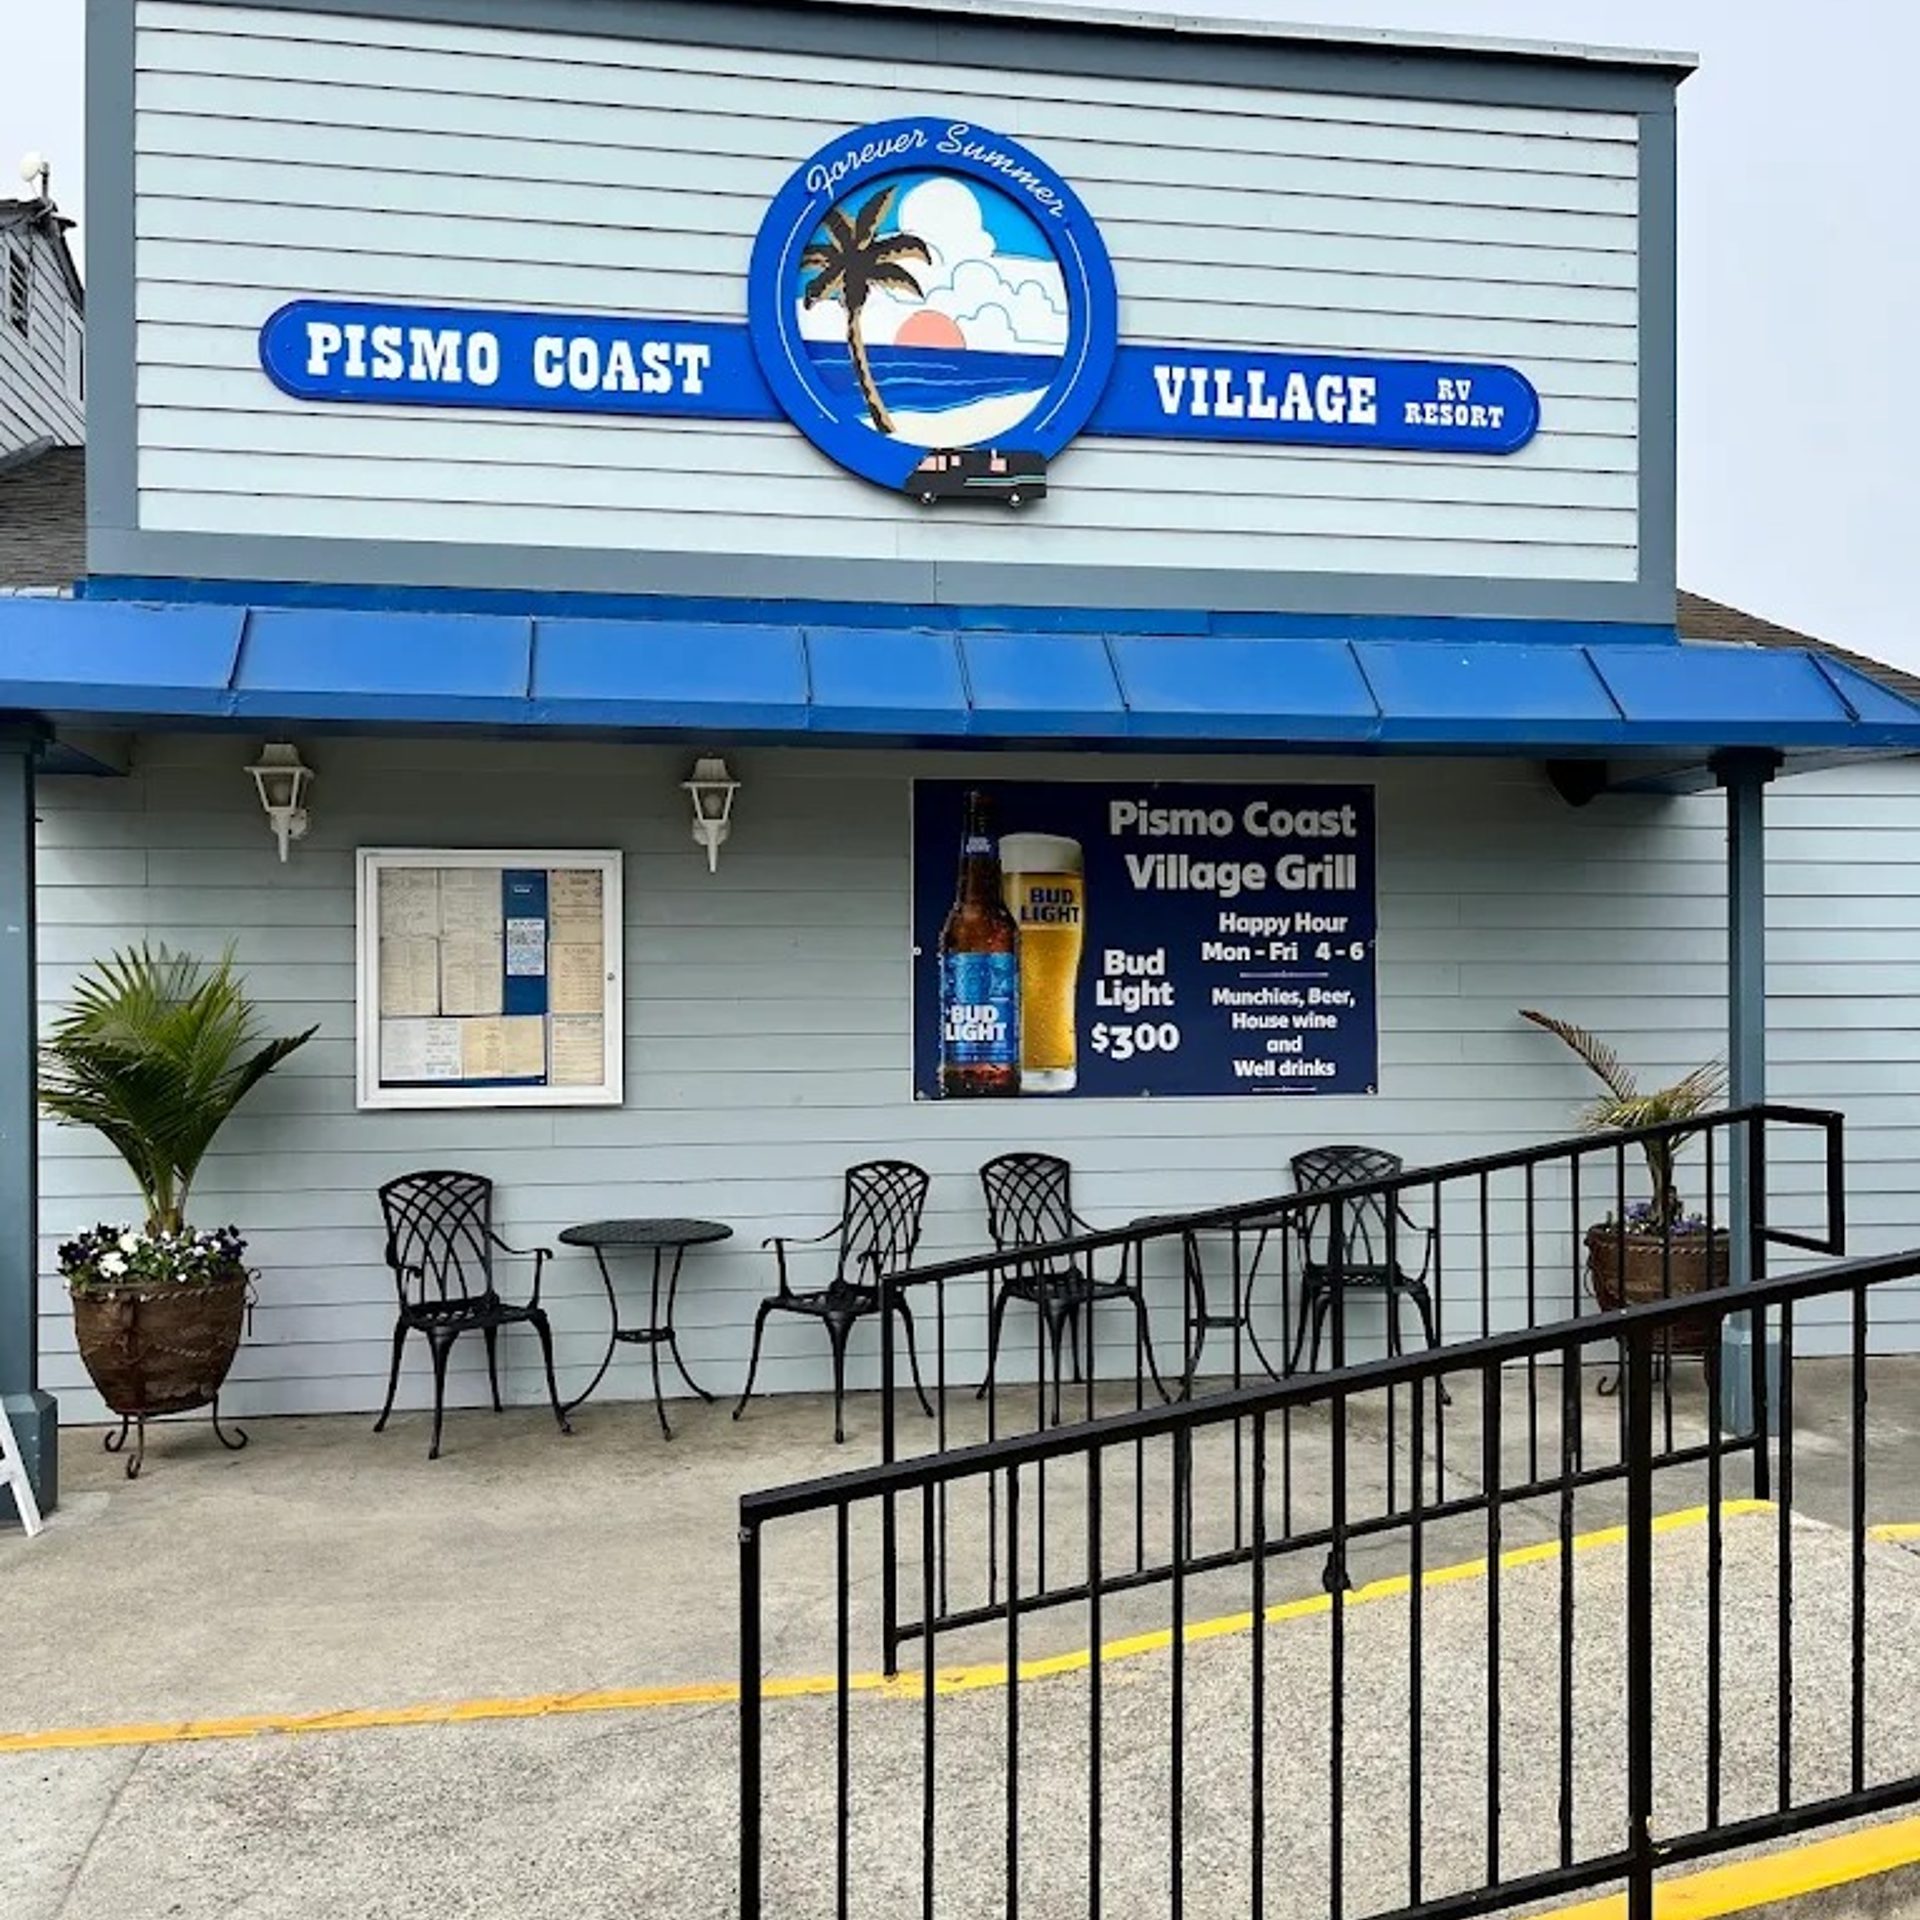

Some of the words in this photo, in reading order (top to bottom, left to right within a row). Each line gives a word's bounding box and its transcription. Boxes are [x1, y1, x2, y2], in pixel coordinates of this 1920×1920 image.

[806, 129, 927, 199] Forever
[936, 124, 1066, 217] Summer
[306, 322, 500, 386] PISMO
[533, 336, 711, 394] COAST
[1154, 365, 1378, 425] VILLAGE
[1437, 379, 1473, 401] RV
[1404, 402, 1505, 429] RESORT
[1109, 800, 1234, 837] Pismo
[1243, 801, 1358, 838] Coast
[1124, 854, 1268, 898] Village
[1275, 854, 1357, 890] Grill
[1030, 886, 1075, 905] BUD
[1020, 906, 1080, 923] LIGHT
[1218, 912, 1291, 936] Happy
[1295, 912, 1349, 933] Hour
[1104, 948, 1165, 976] Bud
[1201, 942, 1251, 961] Mon
[1269, 942, 1299, 961] Fri
[1095, 980, 1175, 1013] Light
[1211, 987, 1305, 1008] Munchies,
[1308, 987, 1356, 1008] Beer,
[950, 1005, 1000, 1023] BUD
[1231, 1012, 1290, 1029] House
[1292, 1011, 1338, 1029] wine
[944, 1023, 1008, 1041] LIGHT
[1266, 1035, 1303, 1053] and
[1233, 1059, 1276, 1077] Well
[1278, 1058, 1336, 1077] drinks
